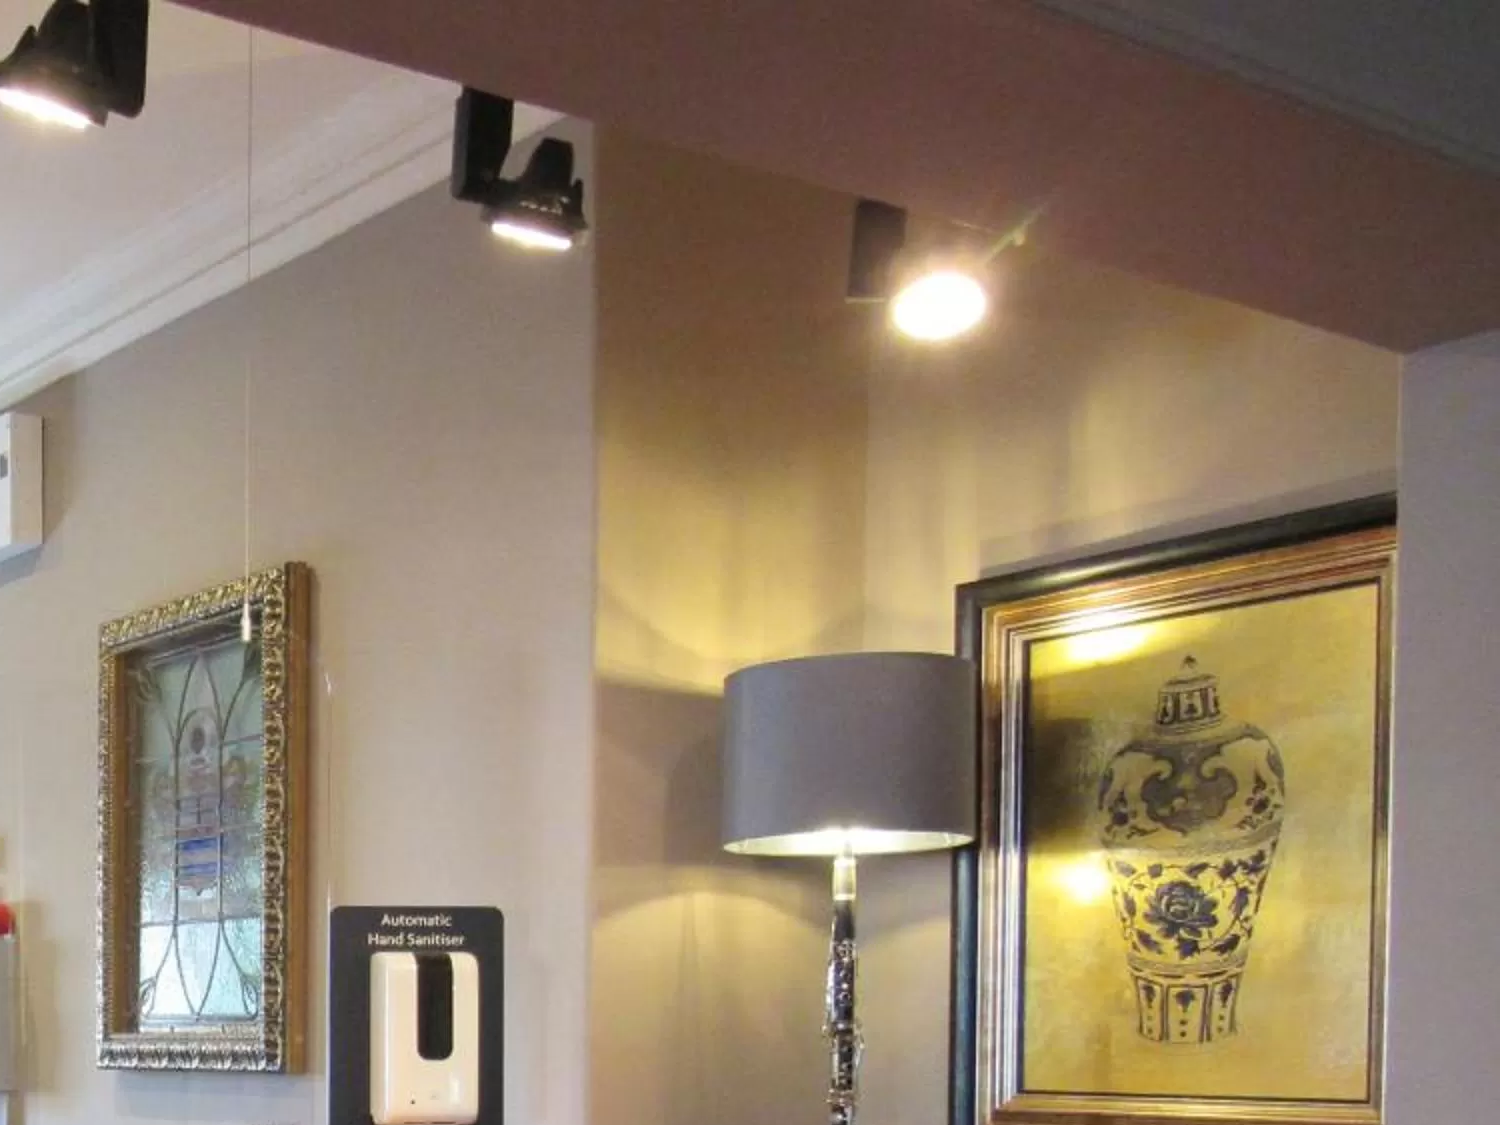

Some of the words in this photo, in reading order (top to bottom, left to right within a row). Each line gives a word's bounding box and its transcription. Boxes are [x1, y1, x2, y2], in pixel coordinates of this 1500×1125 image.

[381, 913, 453, 927] Automatic
[367, 932, 404, 946] Hand
[406, 933, 465, 947] Sanitiser
